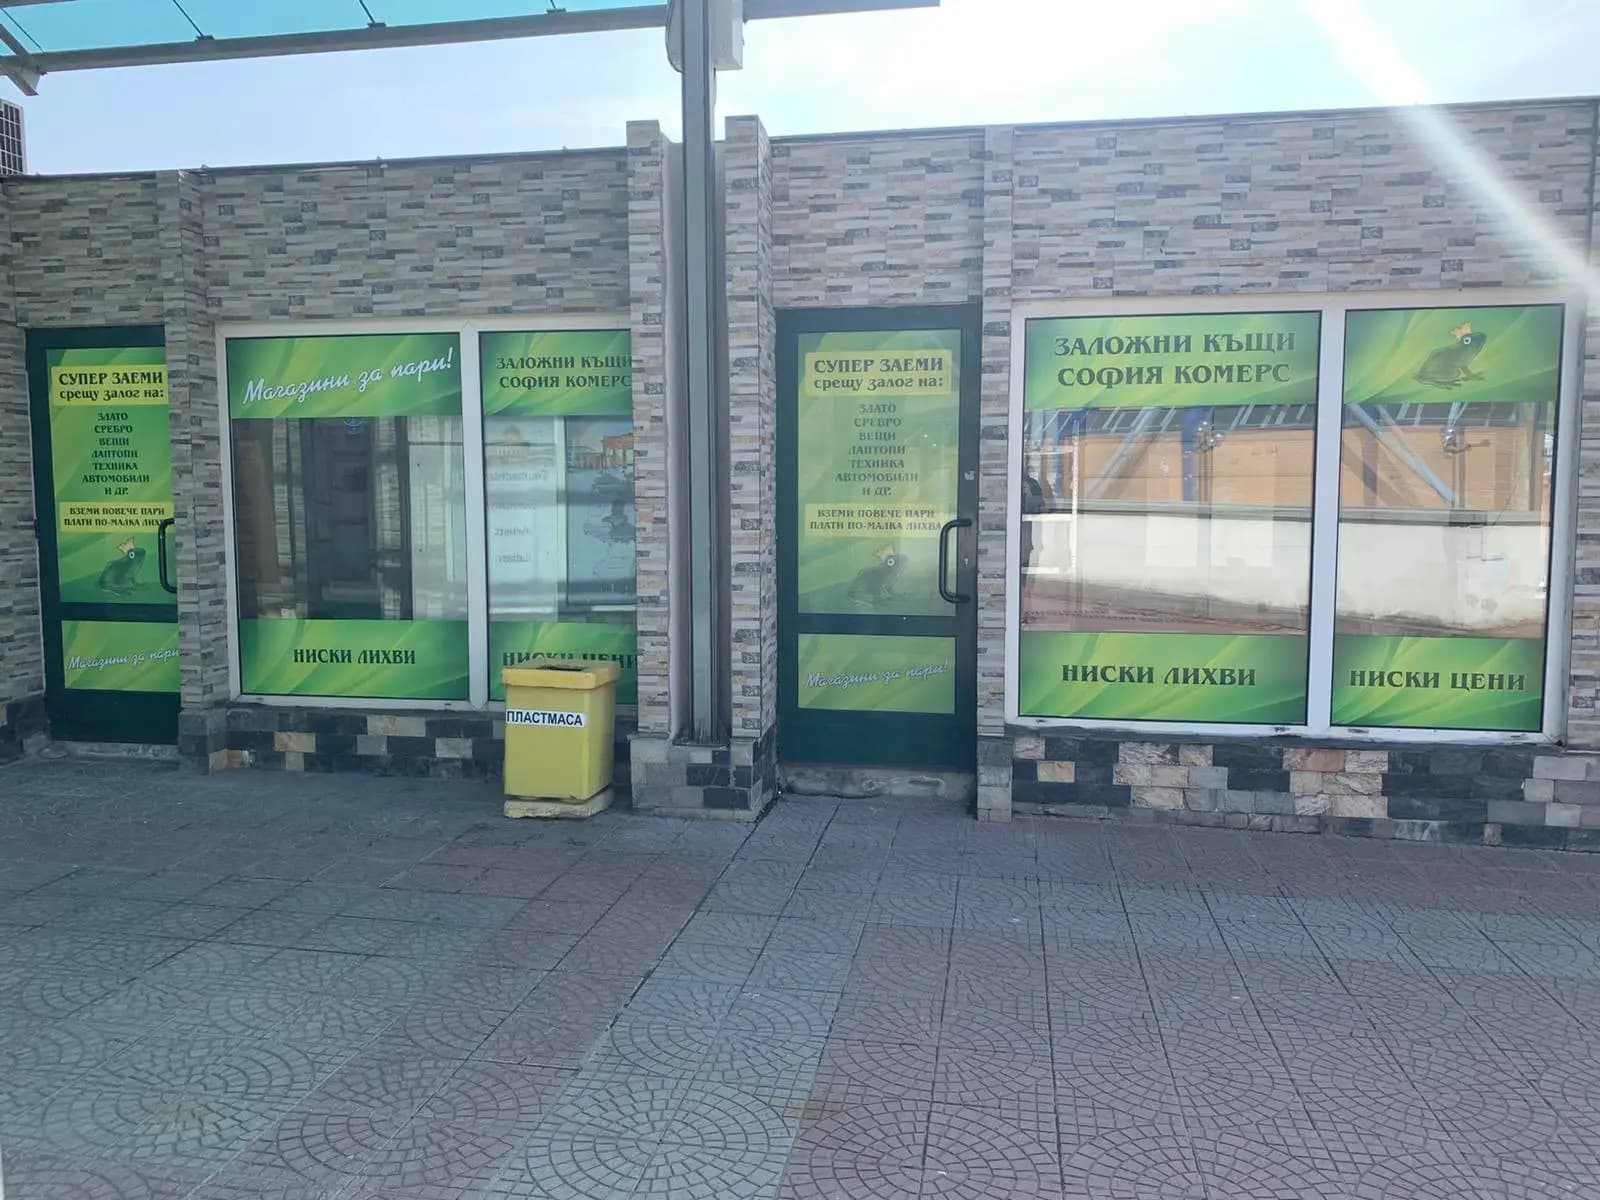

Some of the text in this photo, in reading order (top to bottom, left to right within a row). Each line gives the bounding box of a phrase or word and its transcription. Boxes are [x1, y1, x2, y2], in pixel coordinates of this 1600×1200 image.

[1054, 332, 1295, 357] ЗАЛОЖНИ КЪЩИ
[496, 355, 632, 369] ЗАЛОЖНИ КЪЩИ
[814, 357, 943, 373] СУПЕР ЗАЕМИ
[59, 371, 163, 386] СУПЕР ЗАЕМИ
[243, 347, 453, 403] Магазини за пари!
[1057, 364, 1290, 389] СОФИЯ КОМЕРС
[499, 375, 632, 390] СОФИЯ КОМЕРС
[814, 376, 943, 391] срещу залог на:
[59, 388, 164, 402] срещу залог на:
[859, 403, 896, 414] ЗЛАТО
[97, 412, 129, 421] ЗЛАТО
[853, 417, 902, 428] СРЕБРО
[94, 424, 133, 434] СРЕБРО
[98, 437, 130, 446] ВЕЩИ
[859, 431, 896, 441] ВЕЩИ
[91, 449, 138, 458] ЛАПТОПИ
[848, 445, 906, 455] ЛАПТОПИ
[92, 462, 138, 471] ТЕХНИКА
[848, 459, 905, 469] ТЕХНИКА
[82, 474, 150, 483] АВТОМОБИЛИ
[835, 472, 919, 482] АВТОМОБИЛИ
[104, 487, 112, 495] И
[862, 487, 870, 496] И
[69, 507, 165, 516] ВЗЕМИ ПОВЕЧЕ ПАРИ
[817, 508, 935, 518] ВЗЕМИ ПОВЕЧЕ ПАРИ
[64, 518, 93, 527] ПЛАТИ
[95, 518, 140, 527] ПО-МАЛКА
[810, 521, 844, 530] ПЛАТИ
[847, 521, 903, 530] ПО-МАЛКА
[293, 648, 416, 664] НИСКИ ЛИХВИ
[67, 656, 128, 671] Магазини
[131, 653, 145, 665] за
[806, 671, 878, 689] Магазини
[883, 671, 900, 684] за
[1062, 664, 1256, 686] НИСКИ ЛИХВИ
[1350, 670, 1525, 692] НИСКИ ЦЕНИ
[506, 710, 583, 727] ПЛАСТМАСА
